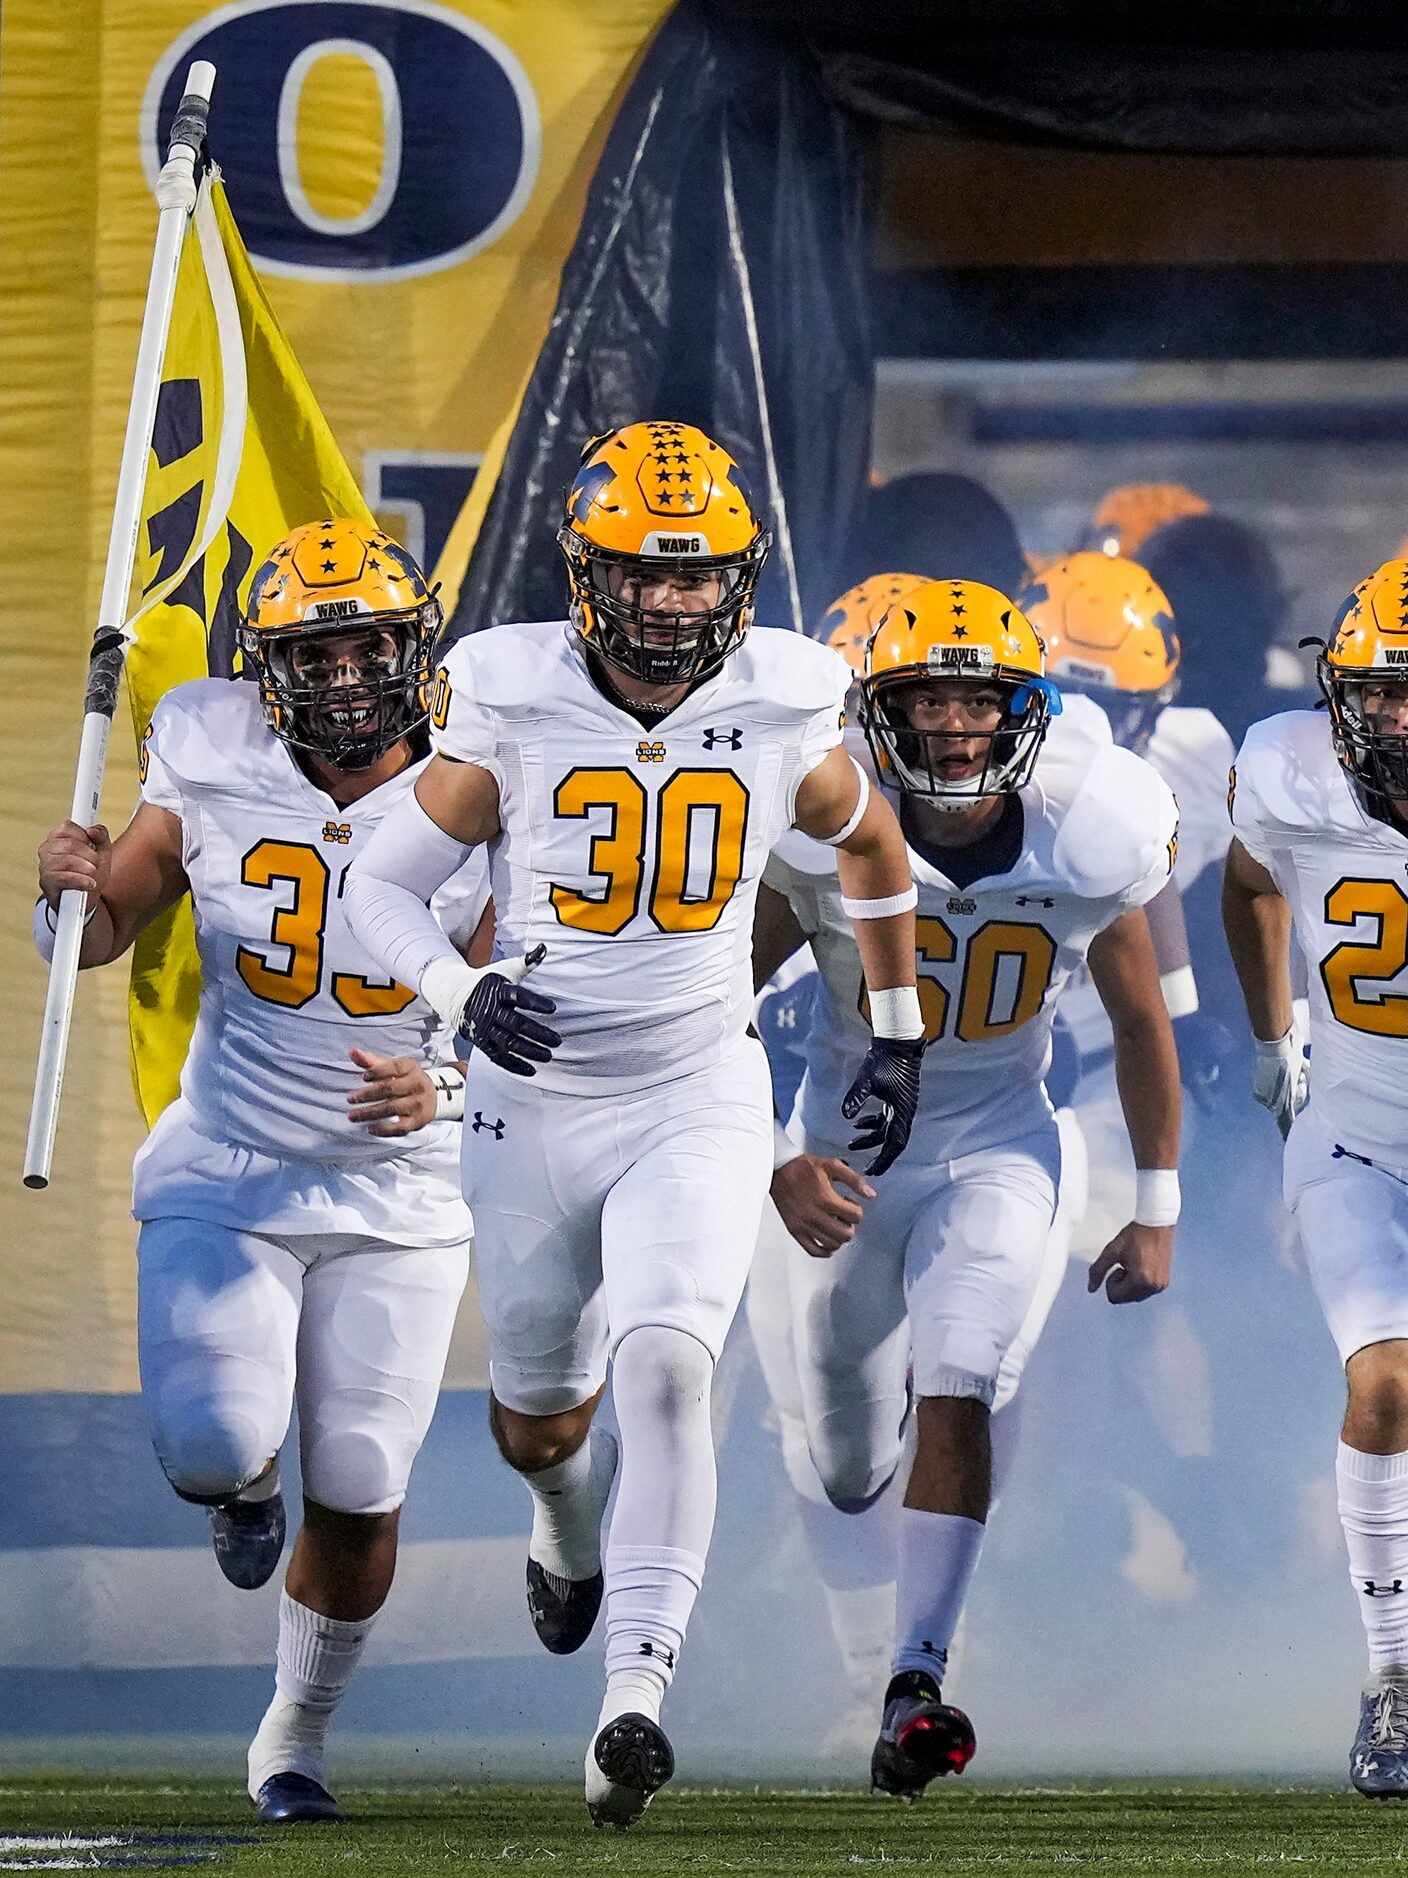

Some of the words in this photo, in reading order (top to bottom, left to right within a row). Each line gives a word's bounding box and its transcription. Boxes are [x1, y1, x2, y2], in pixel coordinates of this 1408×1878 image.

[657, 537, 700, 553] WAWG
[315, 600, 359, 618] WAWG
[941, 648, 979, 662] WAWG
[651, 659, 678, 667] Riddll
[636, 748, 666, 757] LIONS
[322, 828, 353, 839] LIONS
[550, 766, 750, 937] 30
